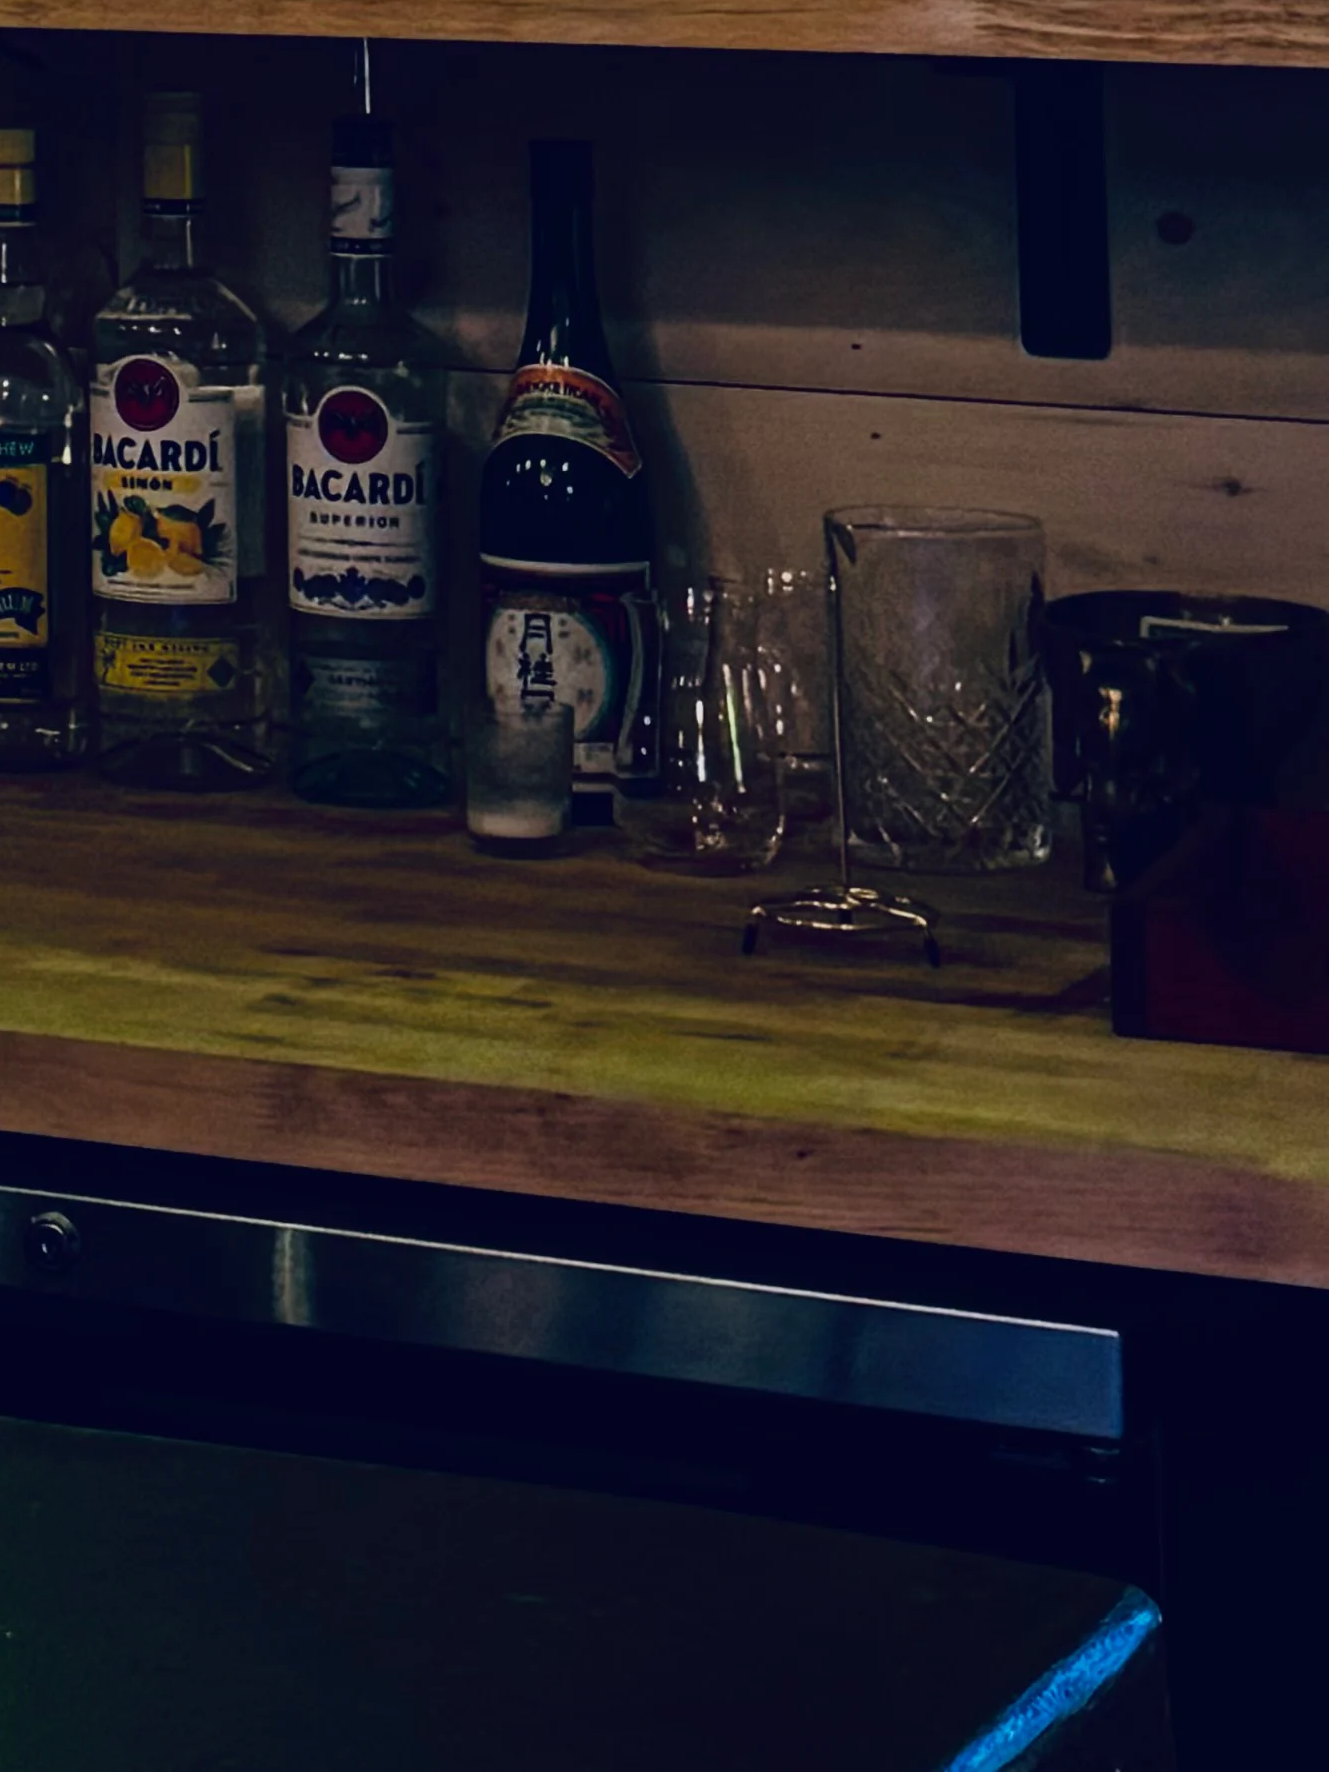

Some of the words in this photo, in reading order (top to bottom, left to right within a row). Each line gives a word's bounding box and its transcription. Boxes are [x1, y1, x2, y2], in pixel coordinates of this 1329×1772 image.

[93, 429, 222, 472] BACARDÍ
[292, 460, 427, 505] BACARDÍ
[309, 511, 401, 529] SUPERIOR
